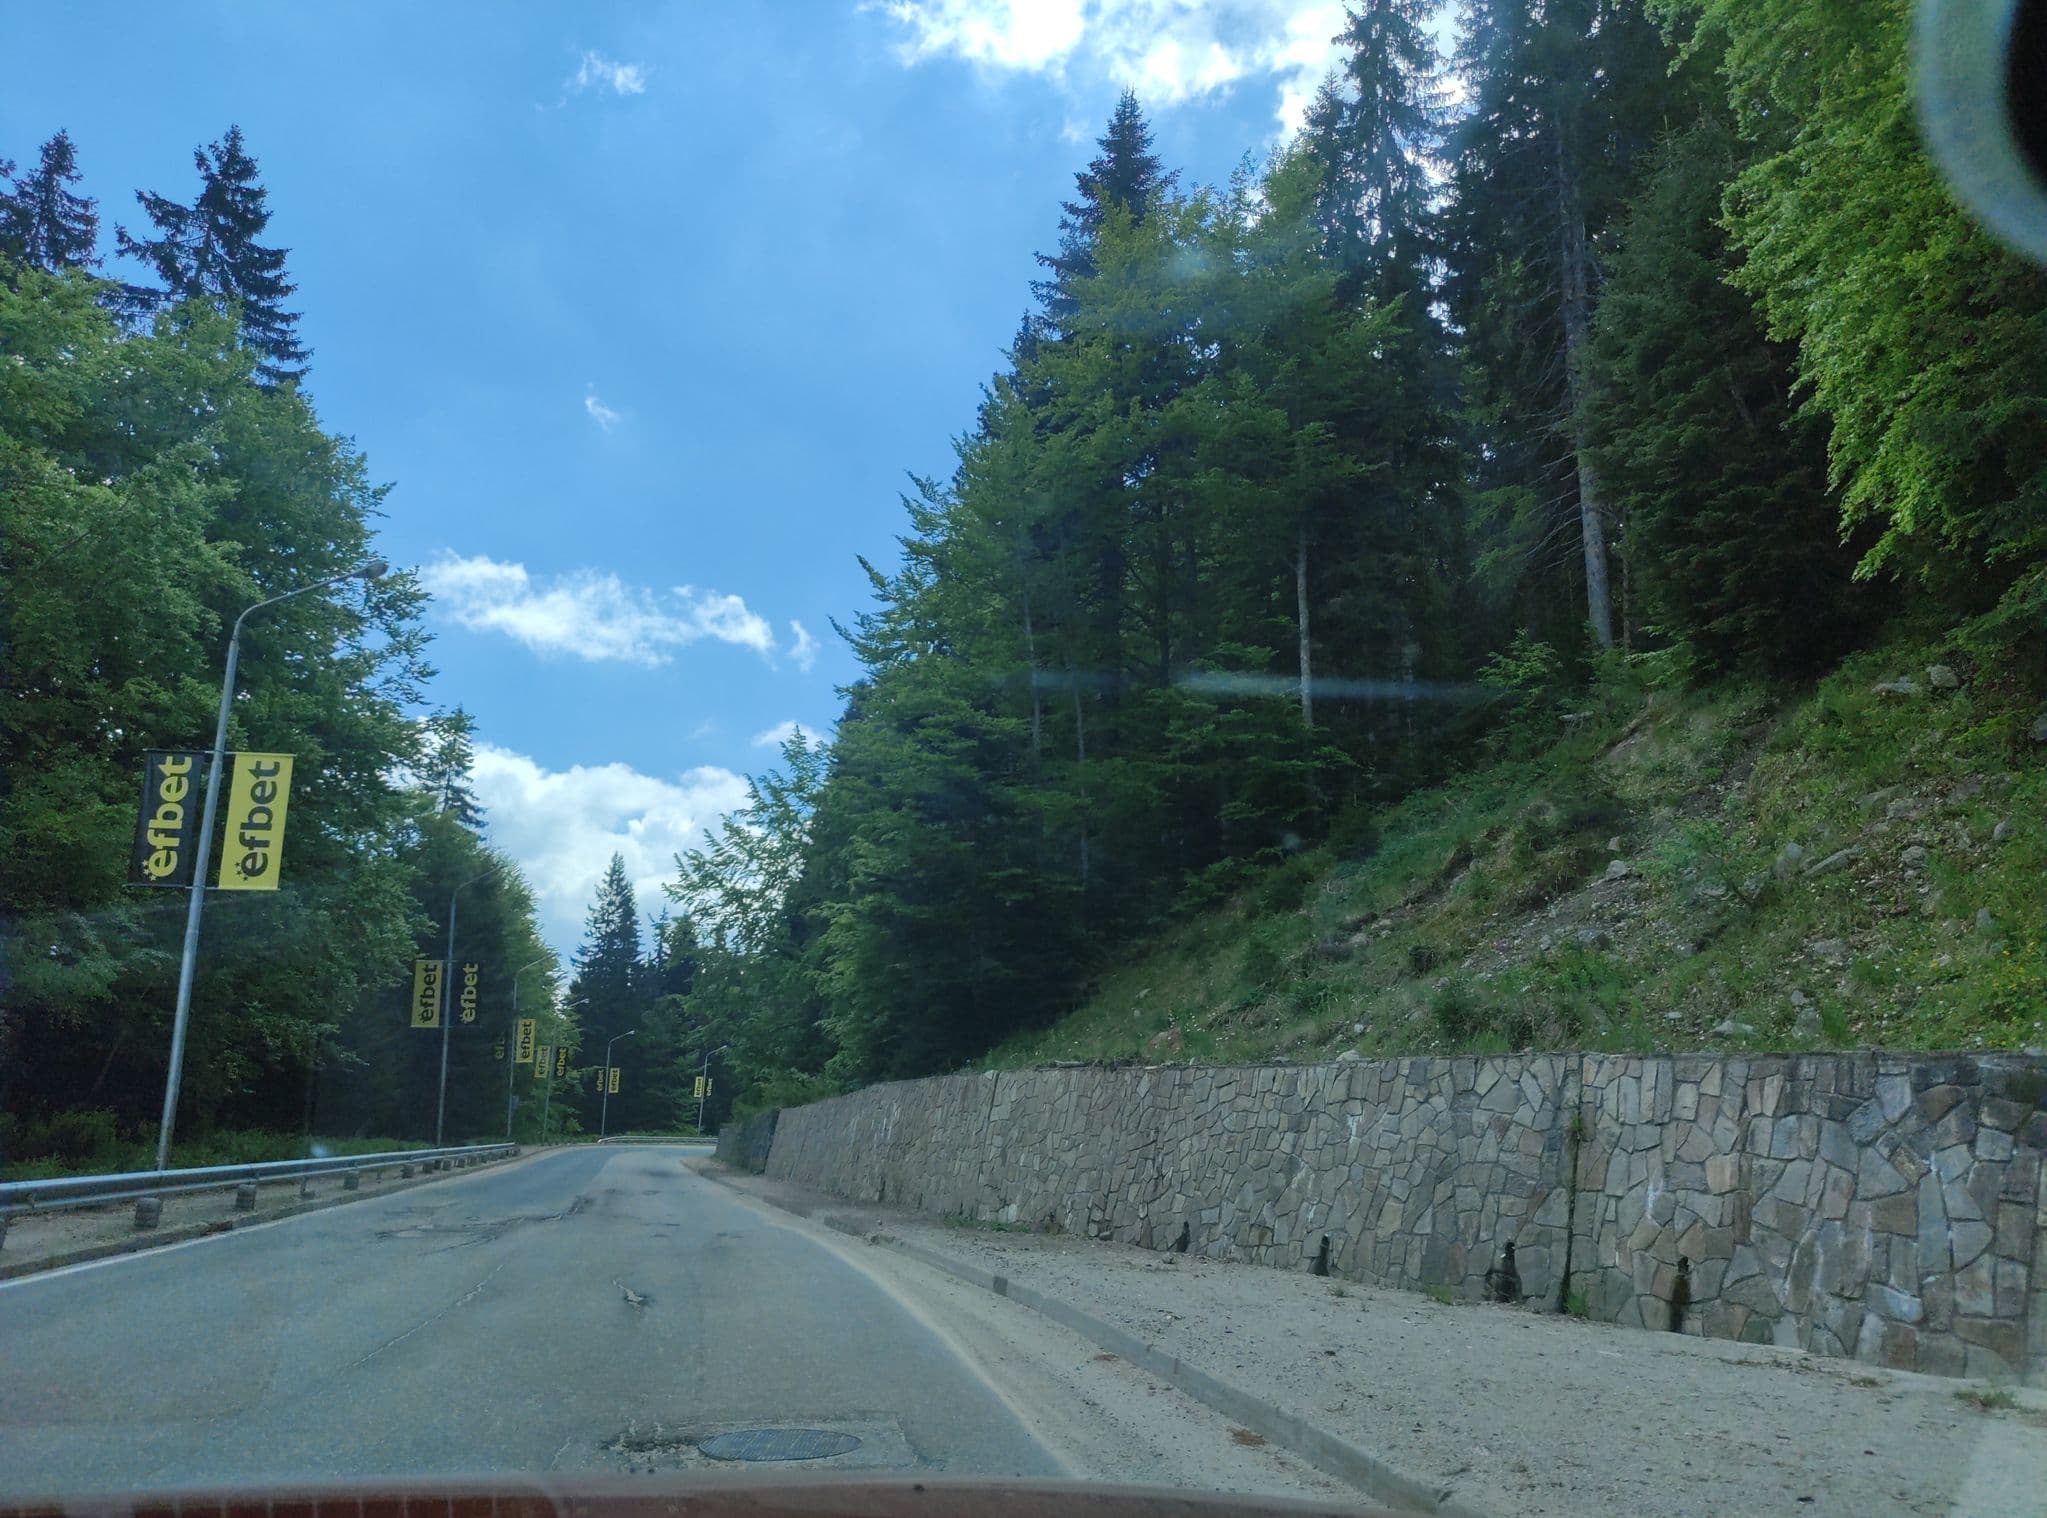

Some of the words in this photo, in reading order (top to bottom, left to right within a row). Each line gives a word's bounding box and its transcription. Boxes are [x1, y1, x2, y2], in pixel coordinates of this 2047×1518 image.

[147, 756, 193, 877] efbet
[239, 760, 281, 877] efbet
[420, 964, 437, 1022] efbet
[461, 963, 478, 1022] efbet
[521, 1021, 532, 1058] efbet
[557, 1047, 567, 1077] efbet
